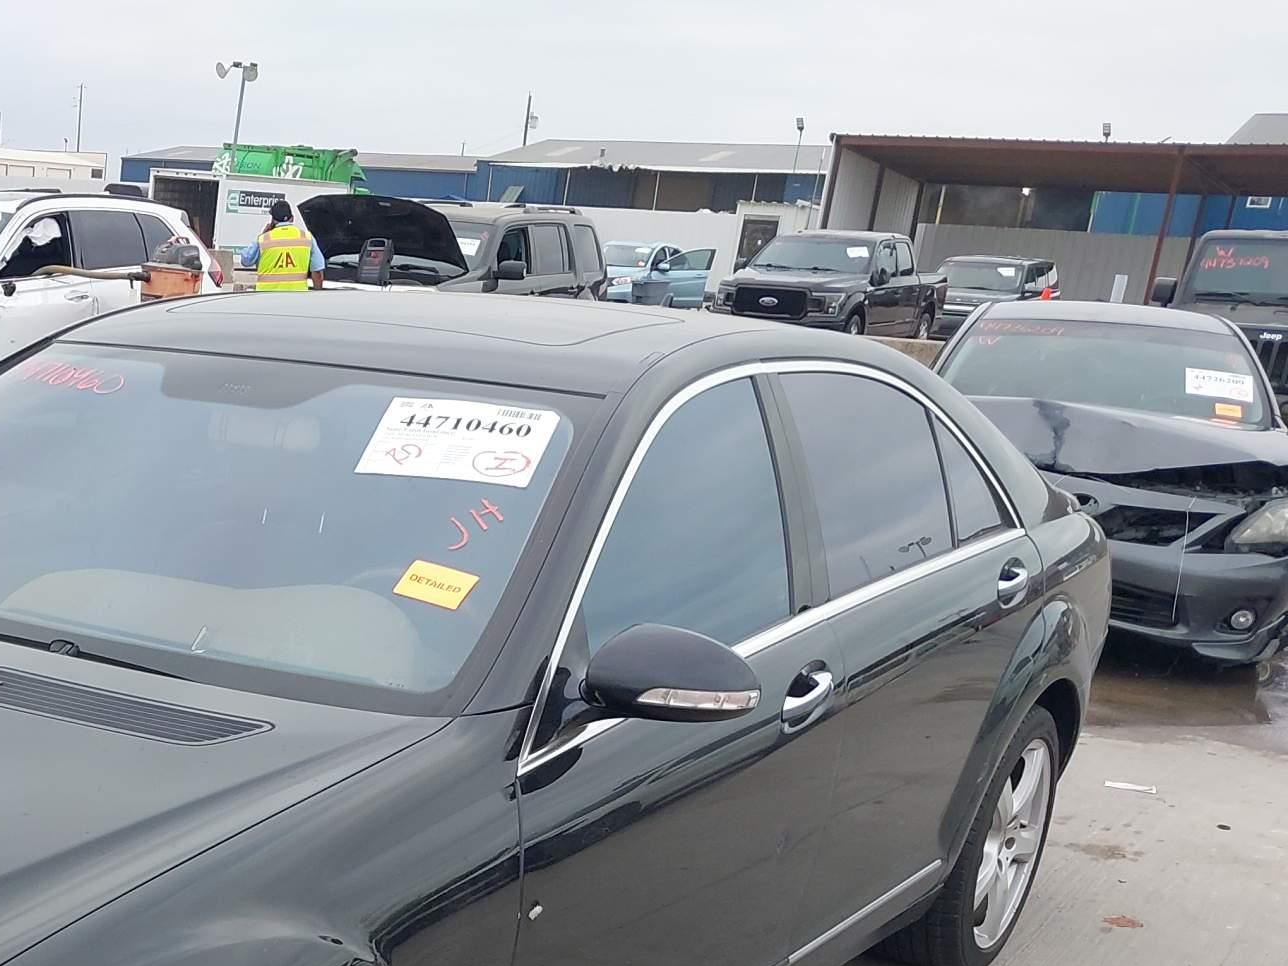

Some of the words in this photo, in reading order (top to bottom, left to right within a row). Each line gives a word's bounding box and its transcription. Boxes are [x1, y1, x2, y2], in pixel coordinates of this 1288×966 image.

[1259, 331, 1283, 341] Jeep
[399, 413, 532, 438] 44710460
[408, 572, 462, 595] DETAILED
